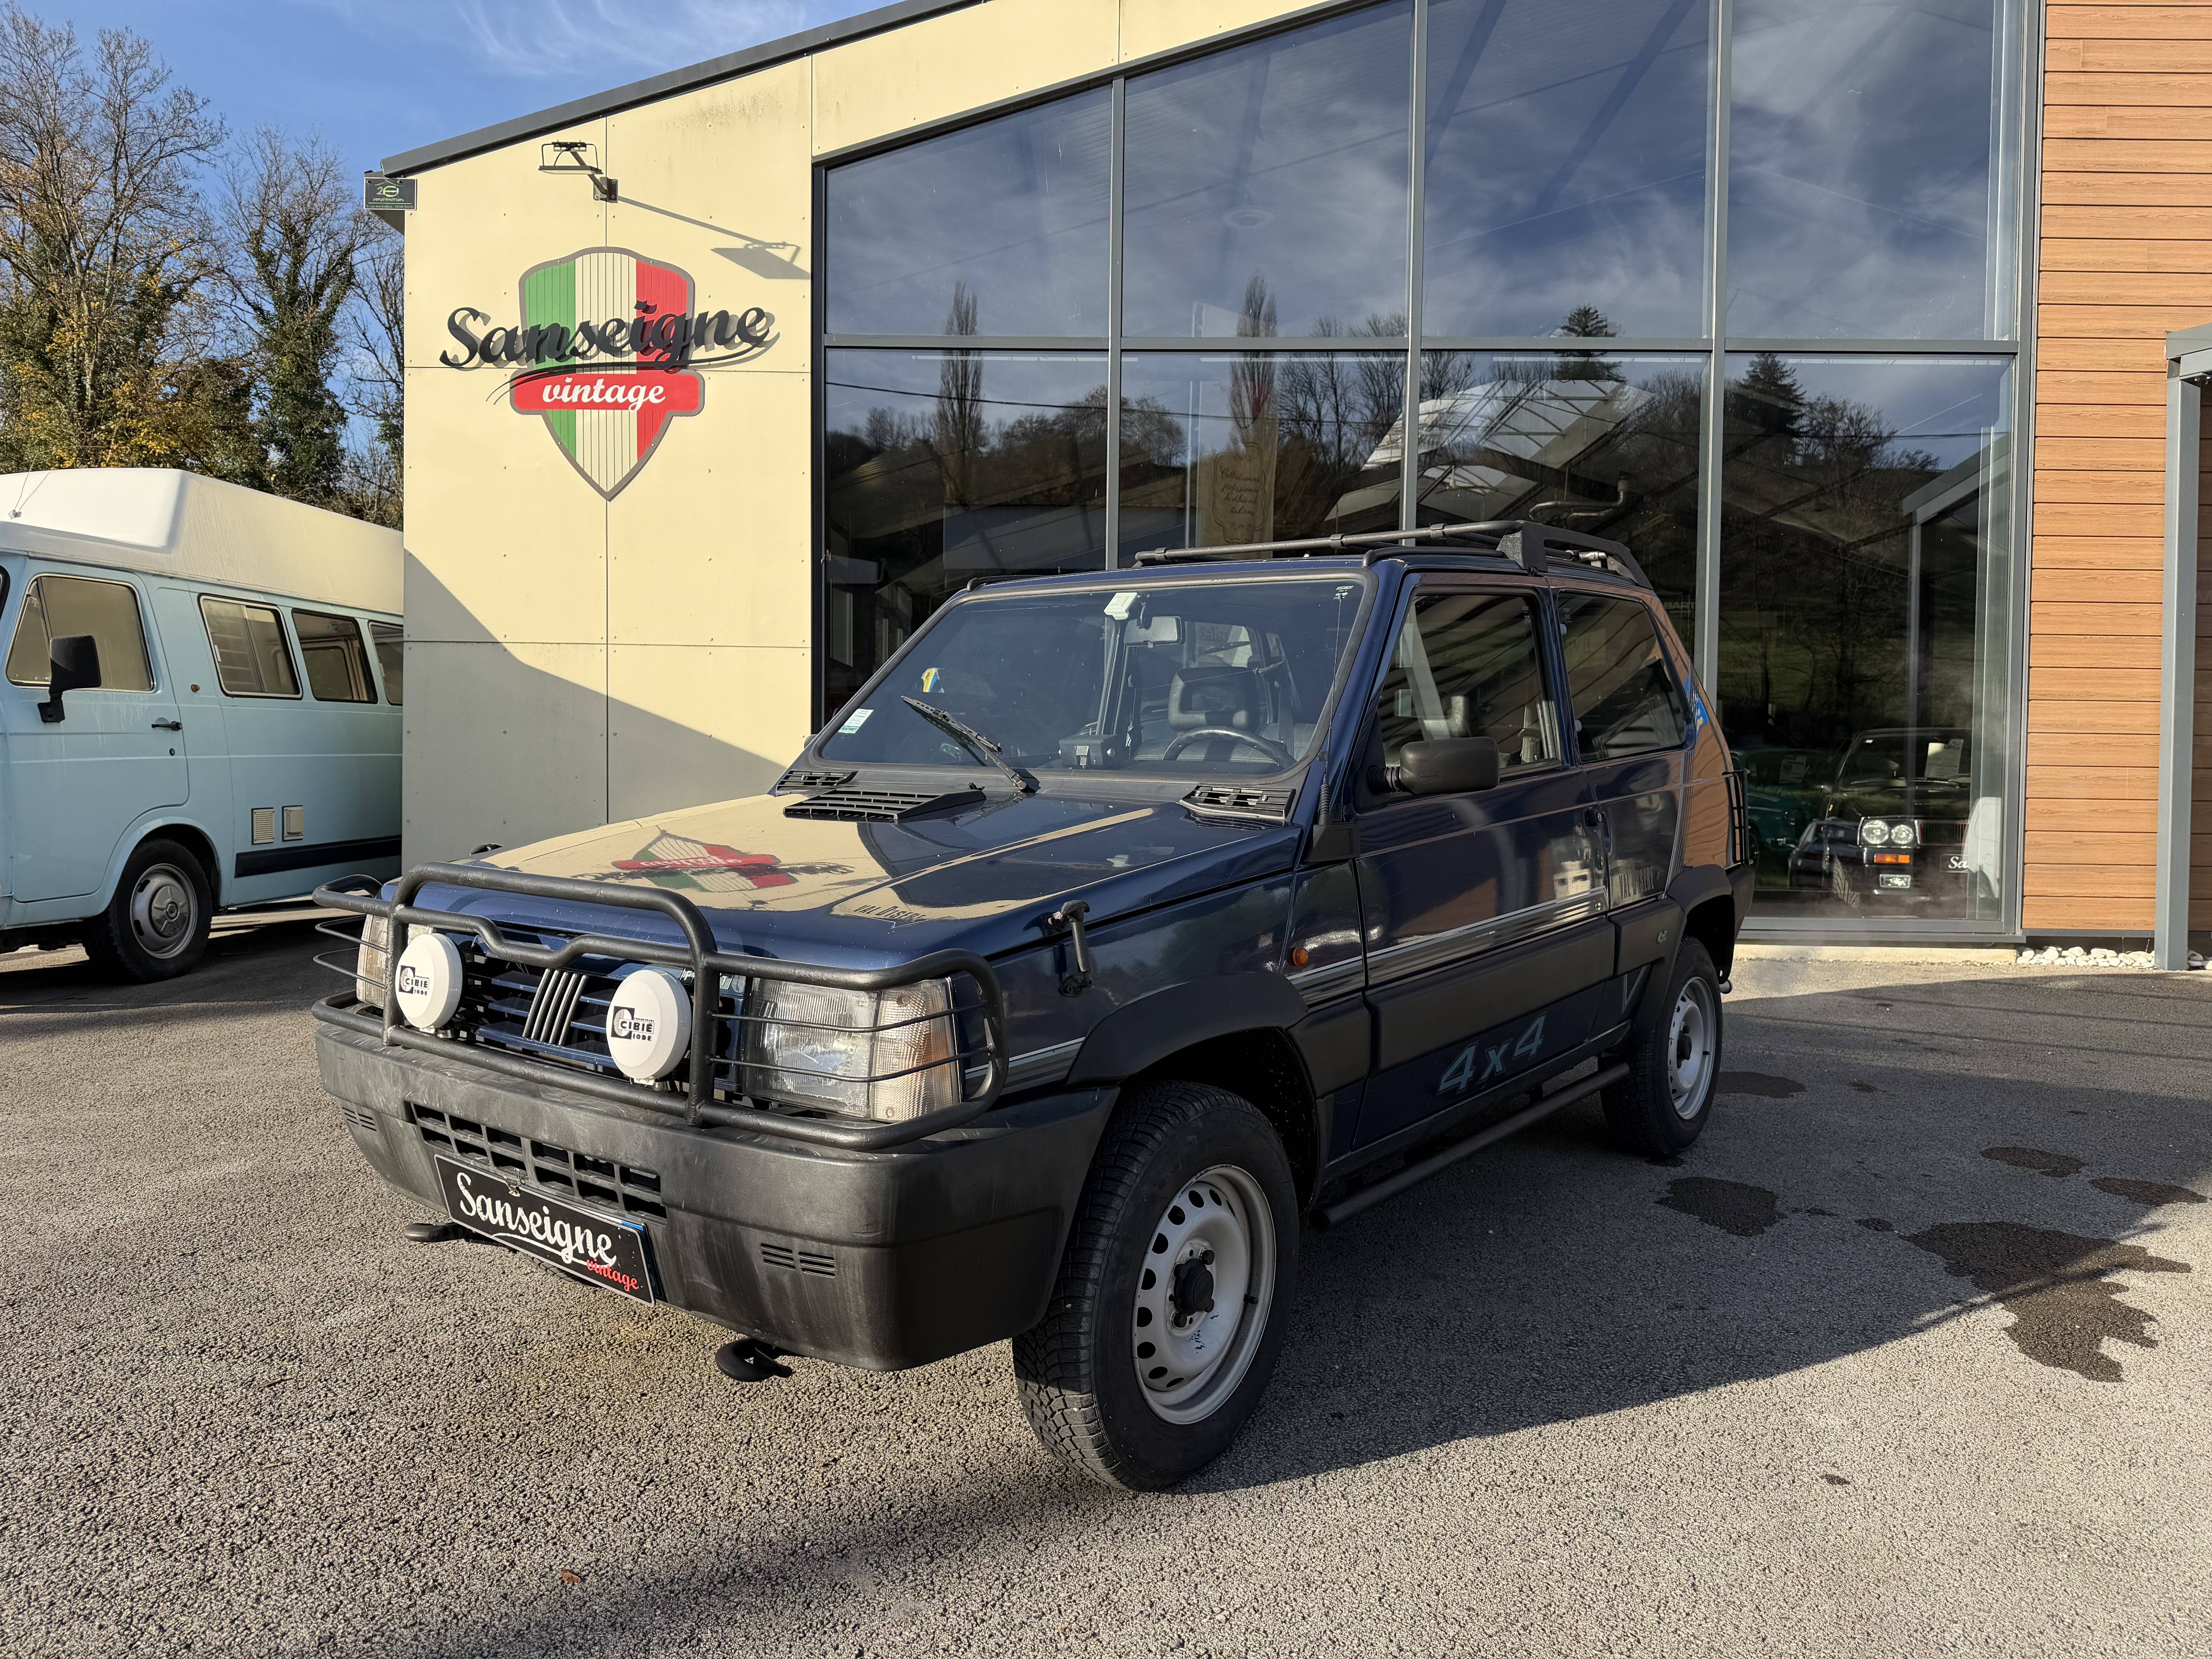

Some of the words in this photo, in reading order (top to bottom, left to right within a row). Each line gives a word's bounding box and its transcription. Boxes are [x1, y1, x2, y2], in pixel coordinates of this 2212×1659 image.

[439, 301, 775, 372] Sanseigne
[543, 377, 666, 412] vintage
[853, 905, 881, 914] VAL
[633, 1033, 652, 1041] IODE
[1436, 1012, 1548, 1097] 4x4
[457, 1172, 617, 1267] Sanseigne
[587, 1258, 639, 1291] vintage
